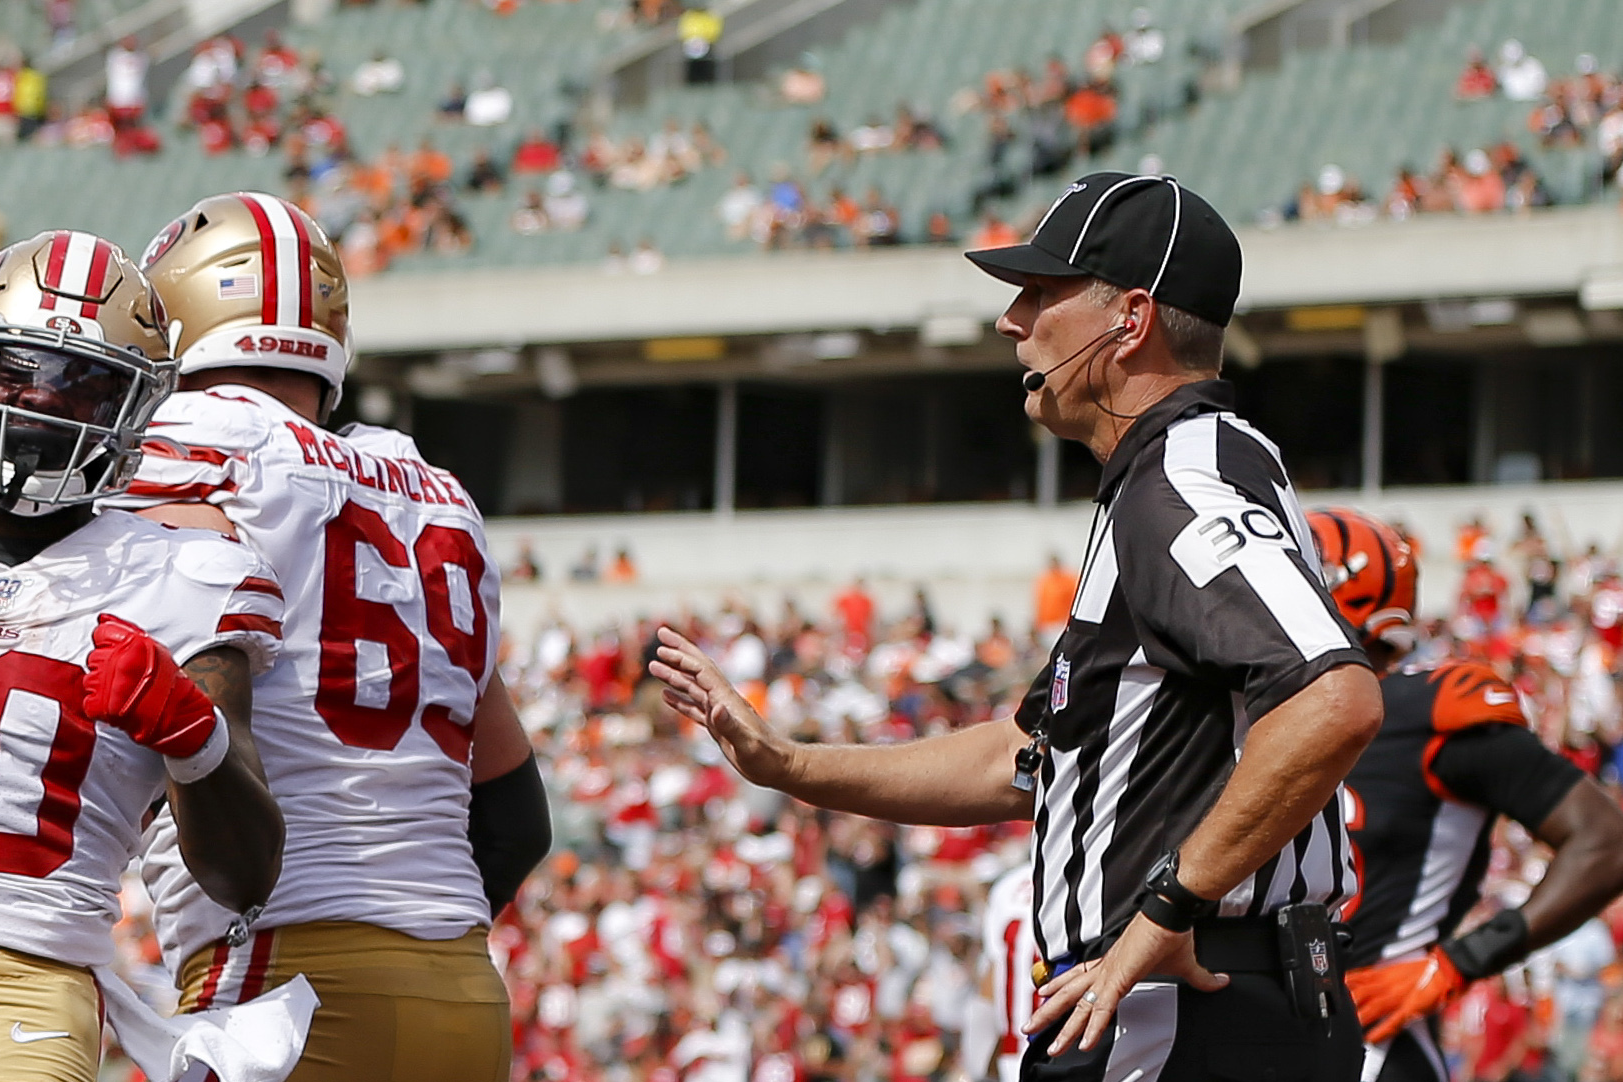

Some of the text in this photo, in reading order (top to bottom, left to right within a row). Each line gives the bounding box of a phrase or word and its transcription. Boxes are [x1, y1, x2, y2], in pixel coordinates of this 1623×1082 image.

[235, 335, 328, 360] 49ERS
[1197, 509, 1284, 563] 30
[314, 498, 488, 766] 69
